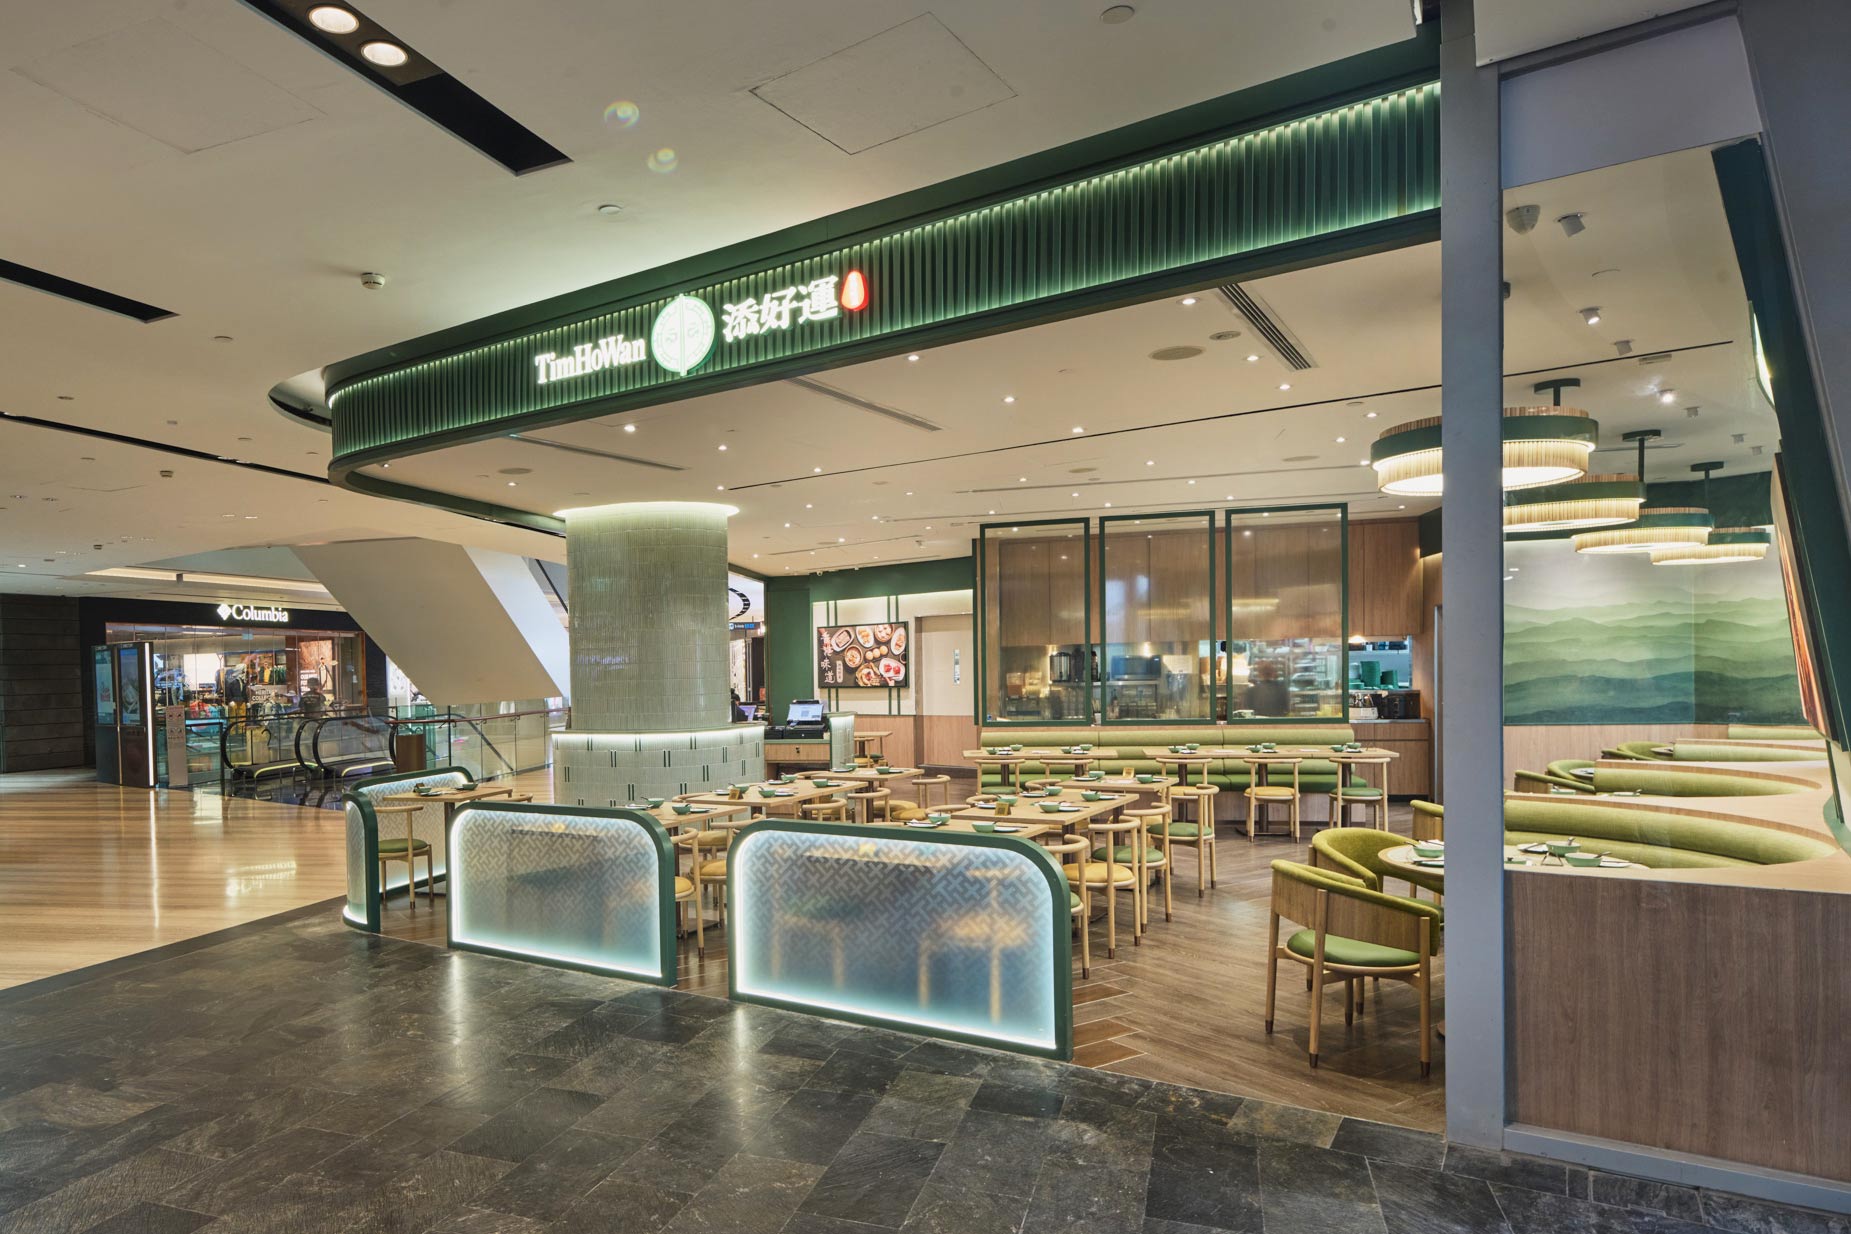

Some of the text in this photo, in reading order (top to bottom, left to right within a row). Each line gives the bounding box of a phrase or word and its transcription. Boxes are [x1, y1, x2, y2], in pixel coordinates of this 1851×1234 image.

[721, 275, 839, 343] 添好運
[232, 604, 288, 622] Columbia
